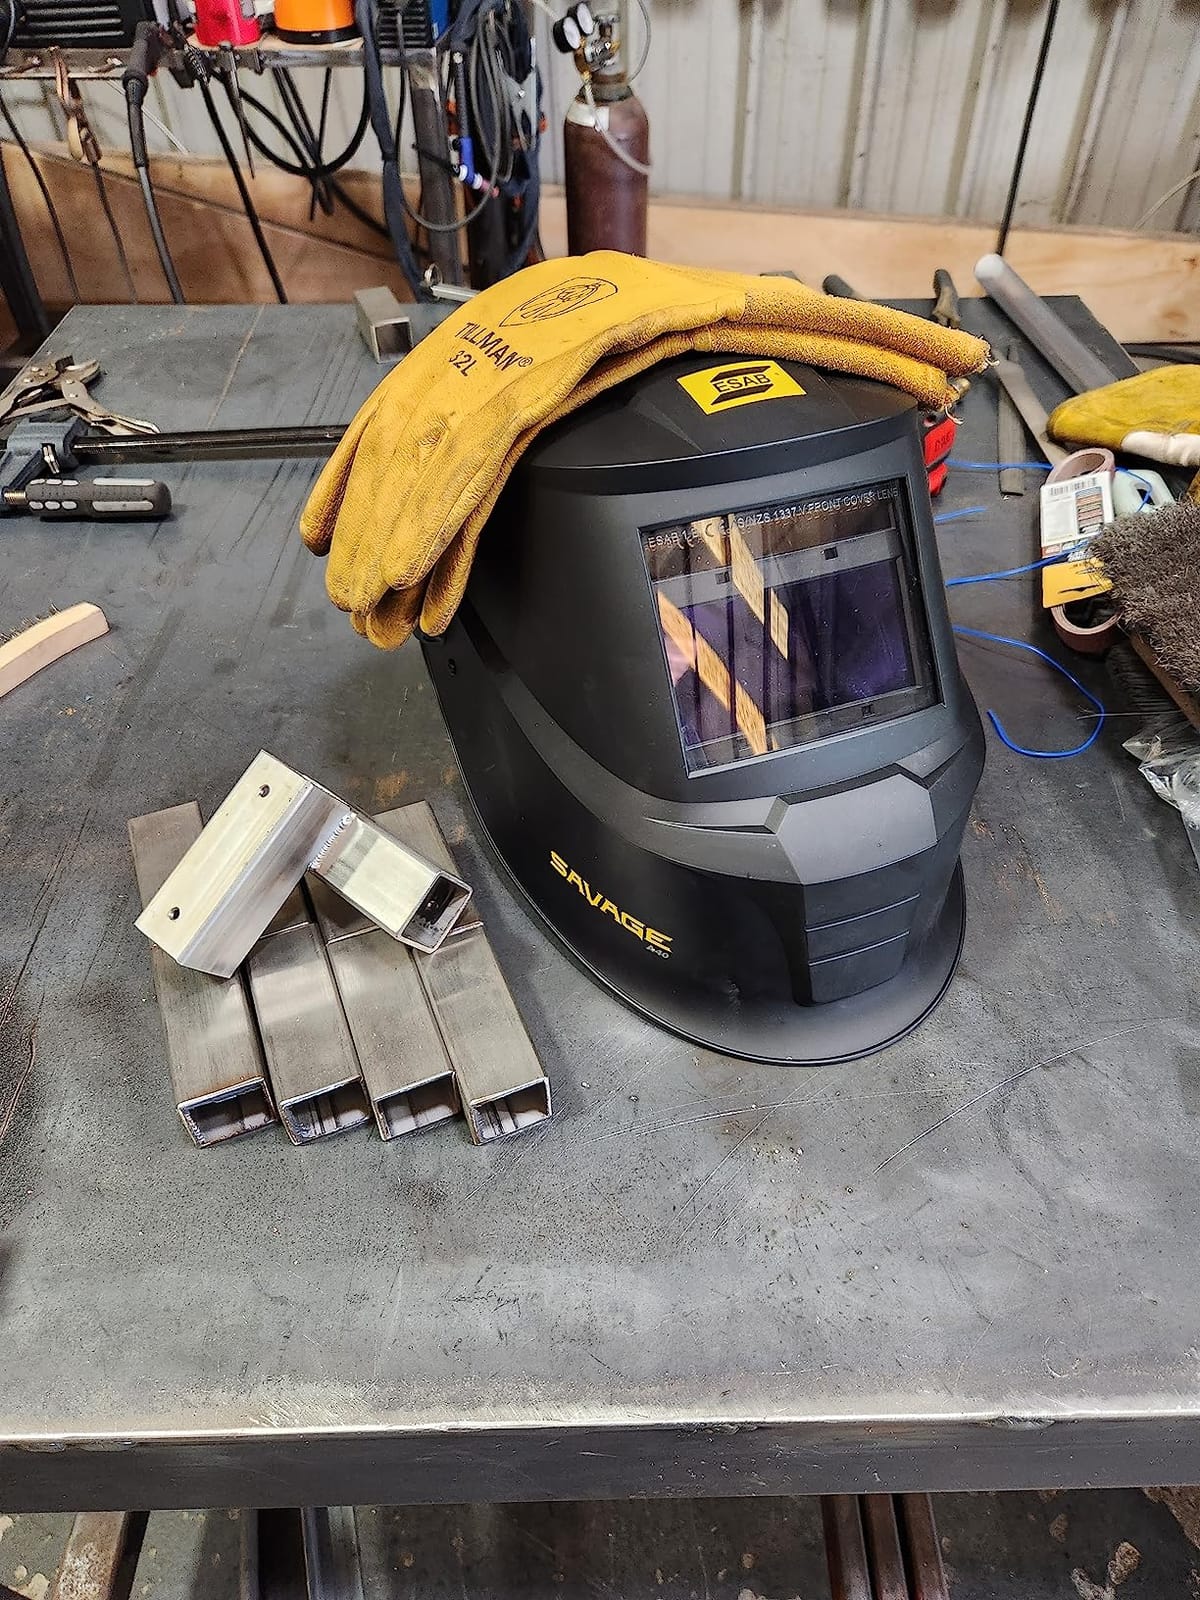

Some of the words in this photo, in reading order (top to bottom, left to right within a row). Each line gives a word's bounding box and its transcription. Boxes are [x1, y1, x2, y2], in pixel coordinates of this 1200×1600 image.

[448, 350, 477, 376] 32L
[712, 373, 770, 393] ESAB
[647, 531, 680, 548] ESAB
[877, 487, 899, 500] LENS
[550, 850, 673, 952] SAVAGE
